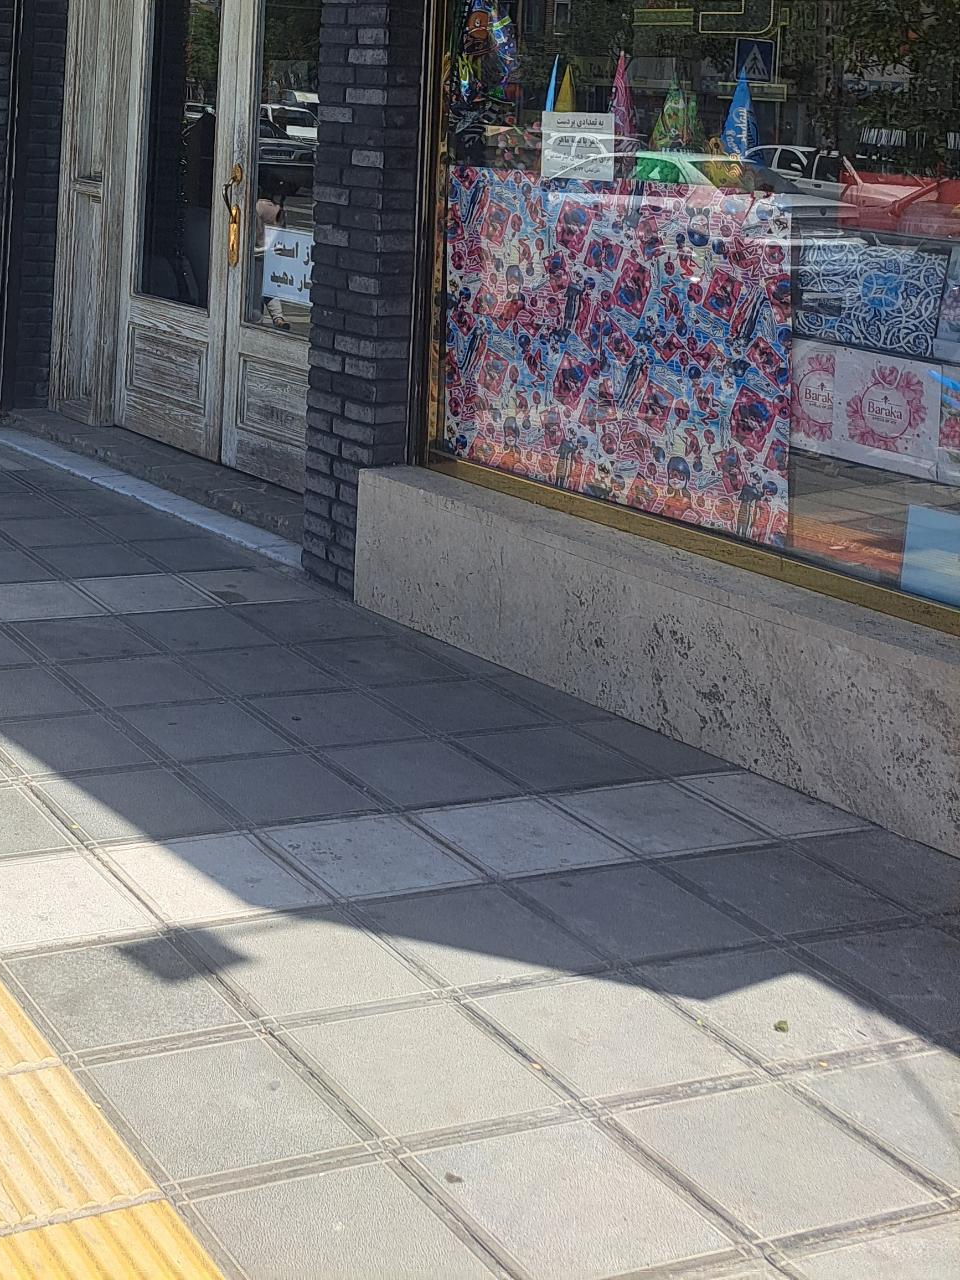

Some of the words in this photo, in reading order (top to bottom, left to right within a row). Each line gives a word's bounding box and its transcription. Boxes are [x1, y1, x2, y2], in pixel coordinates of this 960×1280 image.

[270, 271, 294, 287] دهید
[804, 388, 834, 405] Barak
[867, 400, 903, 420] Baraka
